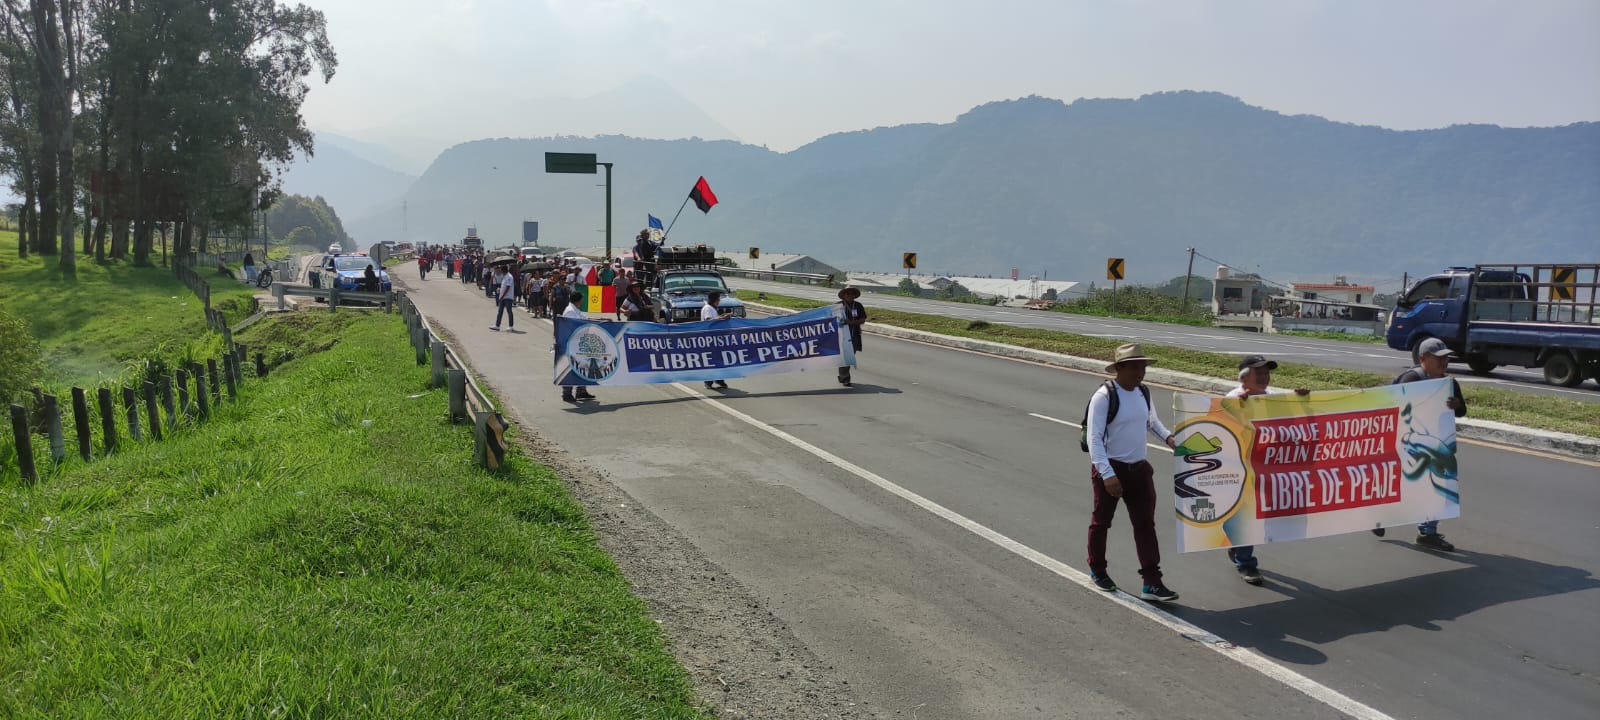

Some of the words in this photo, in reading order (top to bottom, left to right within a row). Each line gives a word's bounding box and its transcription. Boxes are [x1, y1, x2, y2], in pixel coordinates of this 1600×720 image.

[628, 337, 675, 351] BLOQUE
[677, 334, 738, 350] AUTOPISTA
[740, 332, 773, 345] PALIN
[776, 321, 835, 341] ESCUINTLA
[649, 351, 716, 370] LIBRE
[721, 349, 753, 366] DE
[757, 339, 820, 362] PEAJE
[1258, 422, 1320, 445] BLOQUE
[1324, 414, 1394, 440] AUTOPISTA
[1312, 437, 1385, 462] ESCUINTLA
[1259, 470, 1316, 512] LIBRE
[1317, 467, 1345, 505] DE
[1346, 461, 1398, 502] PEAJE
